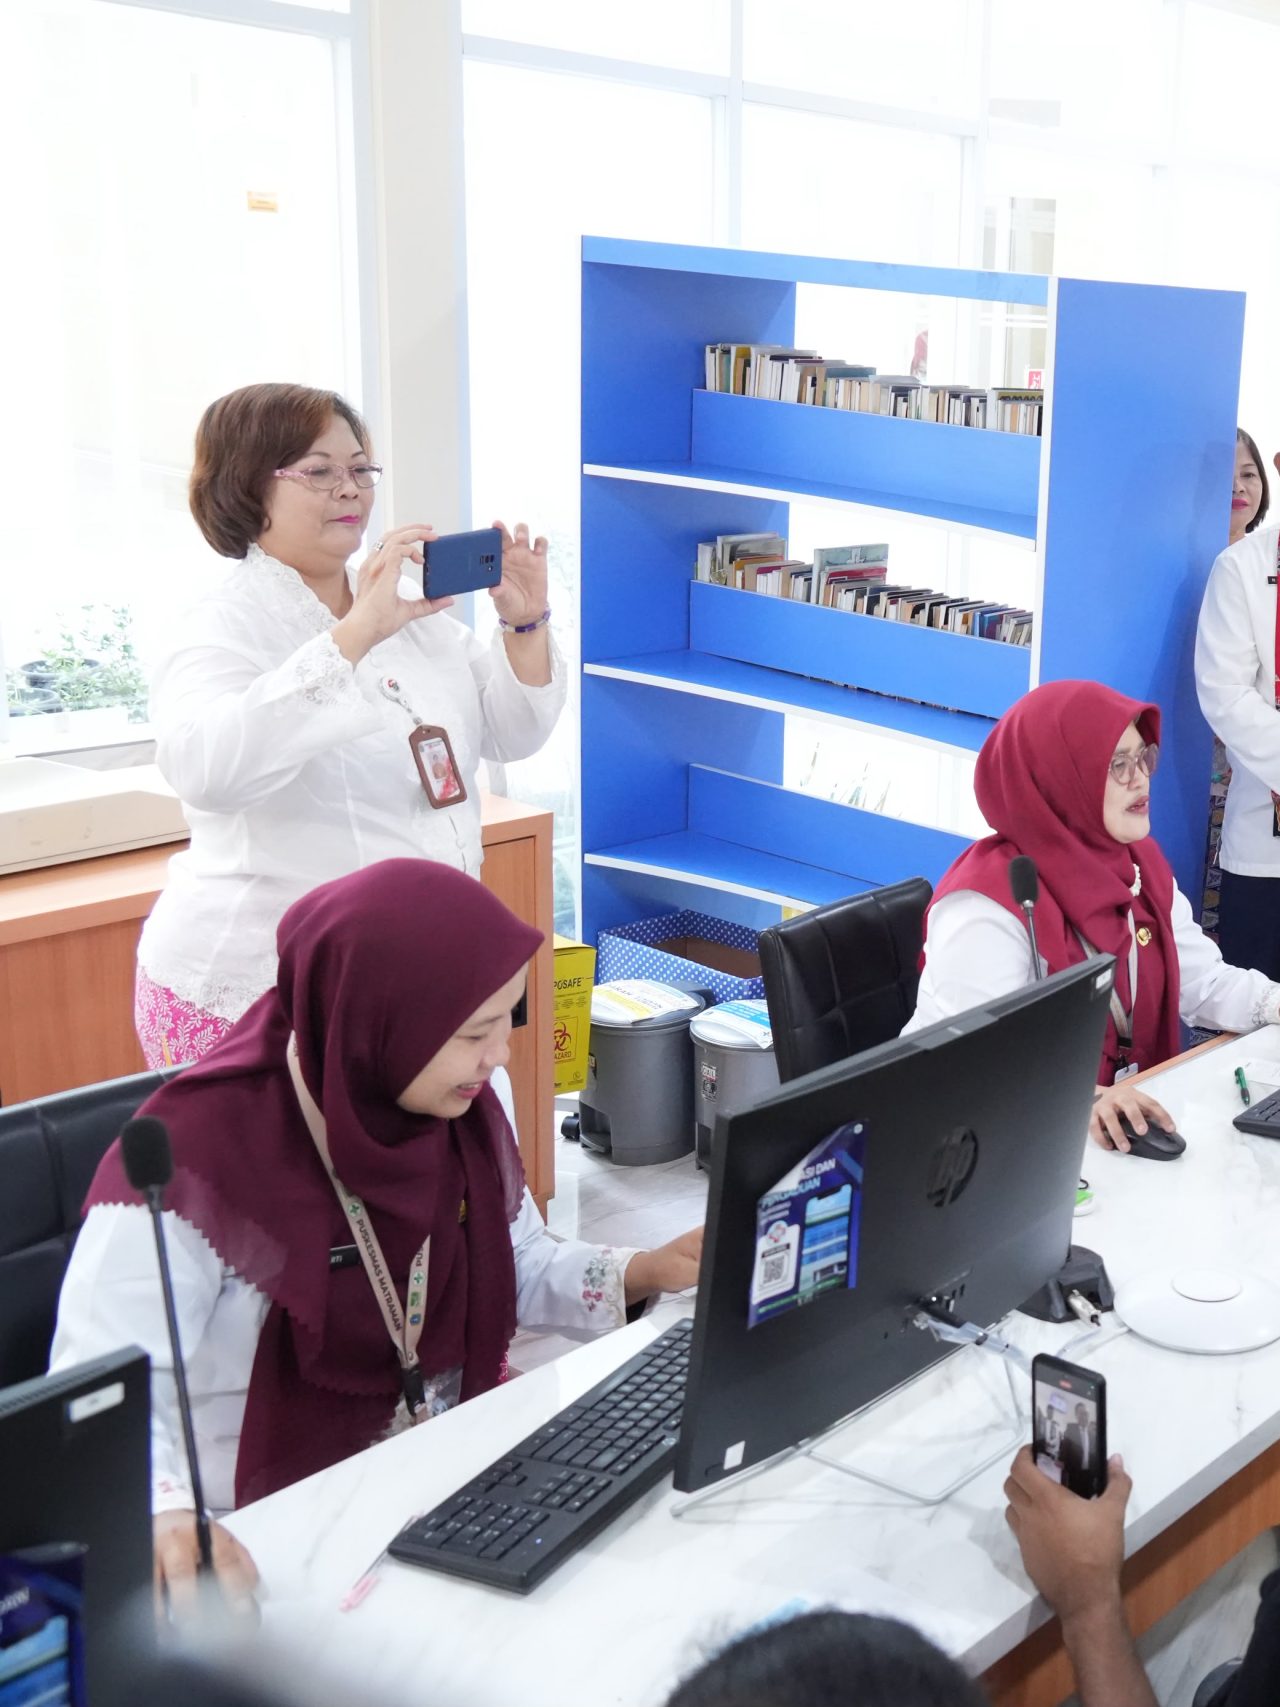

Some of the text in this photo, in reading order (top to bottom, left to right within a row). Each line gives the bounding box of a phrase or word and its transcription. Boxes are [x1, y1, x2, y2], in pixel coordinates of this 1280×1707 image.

[815, 1158, 837, 1175] DAN
[356, 1219, 403, 1332] PUSKESMAS MATRAMAN
